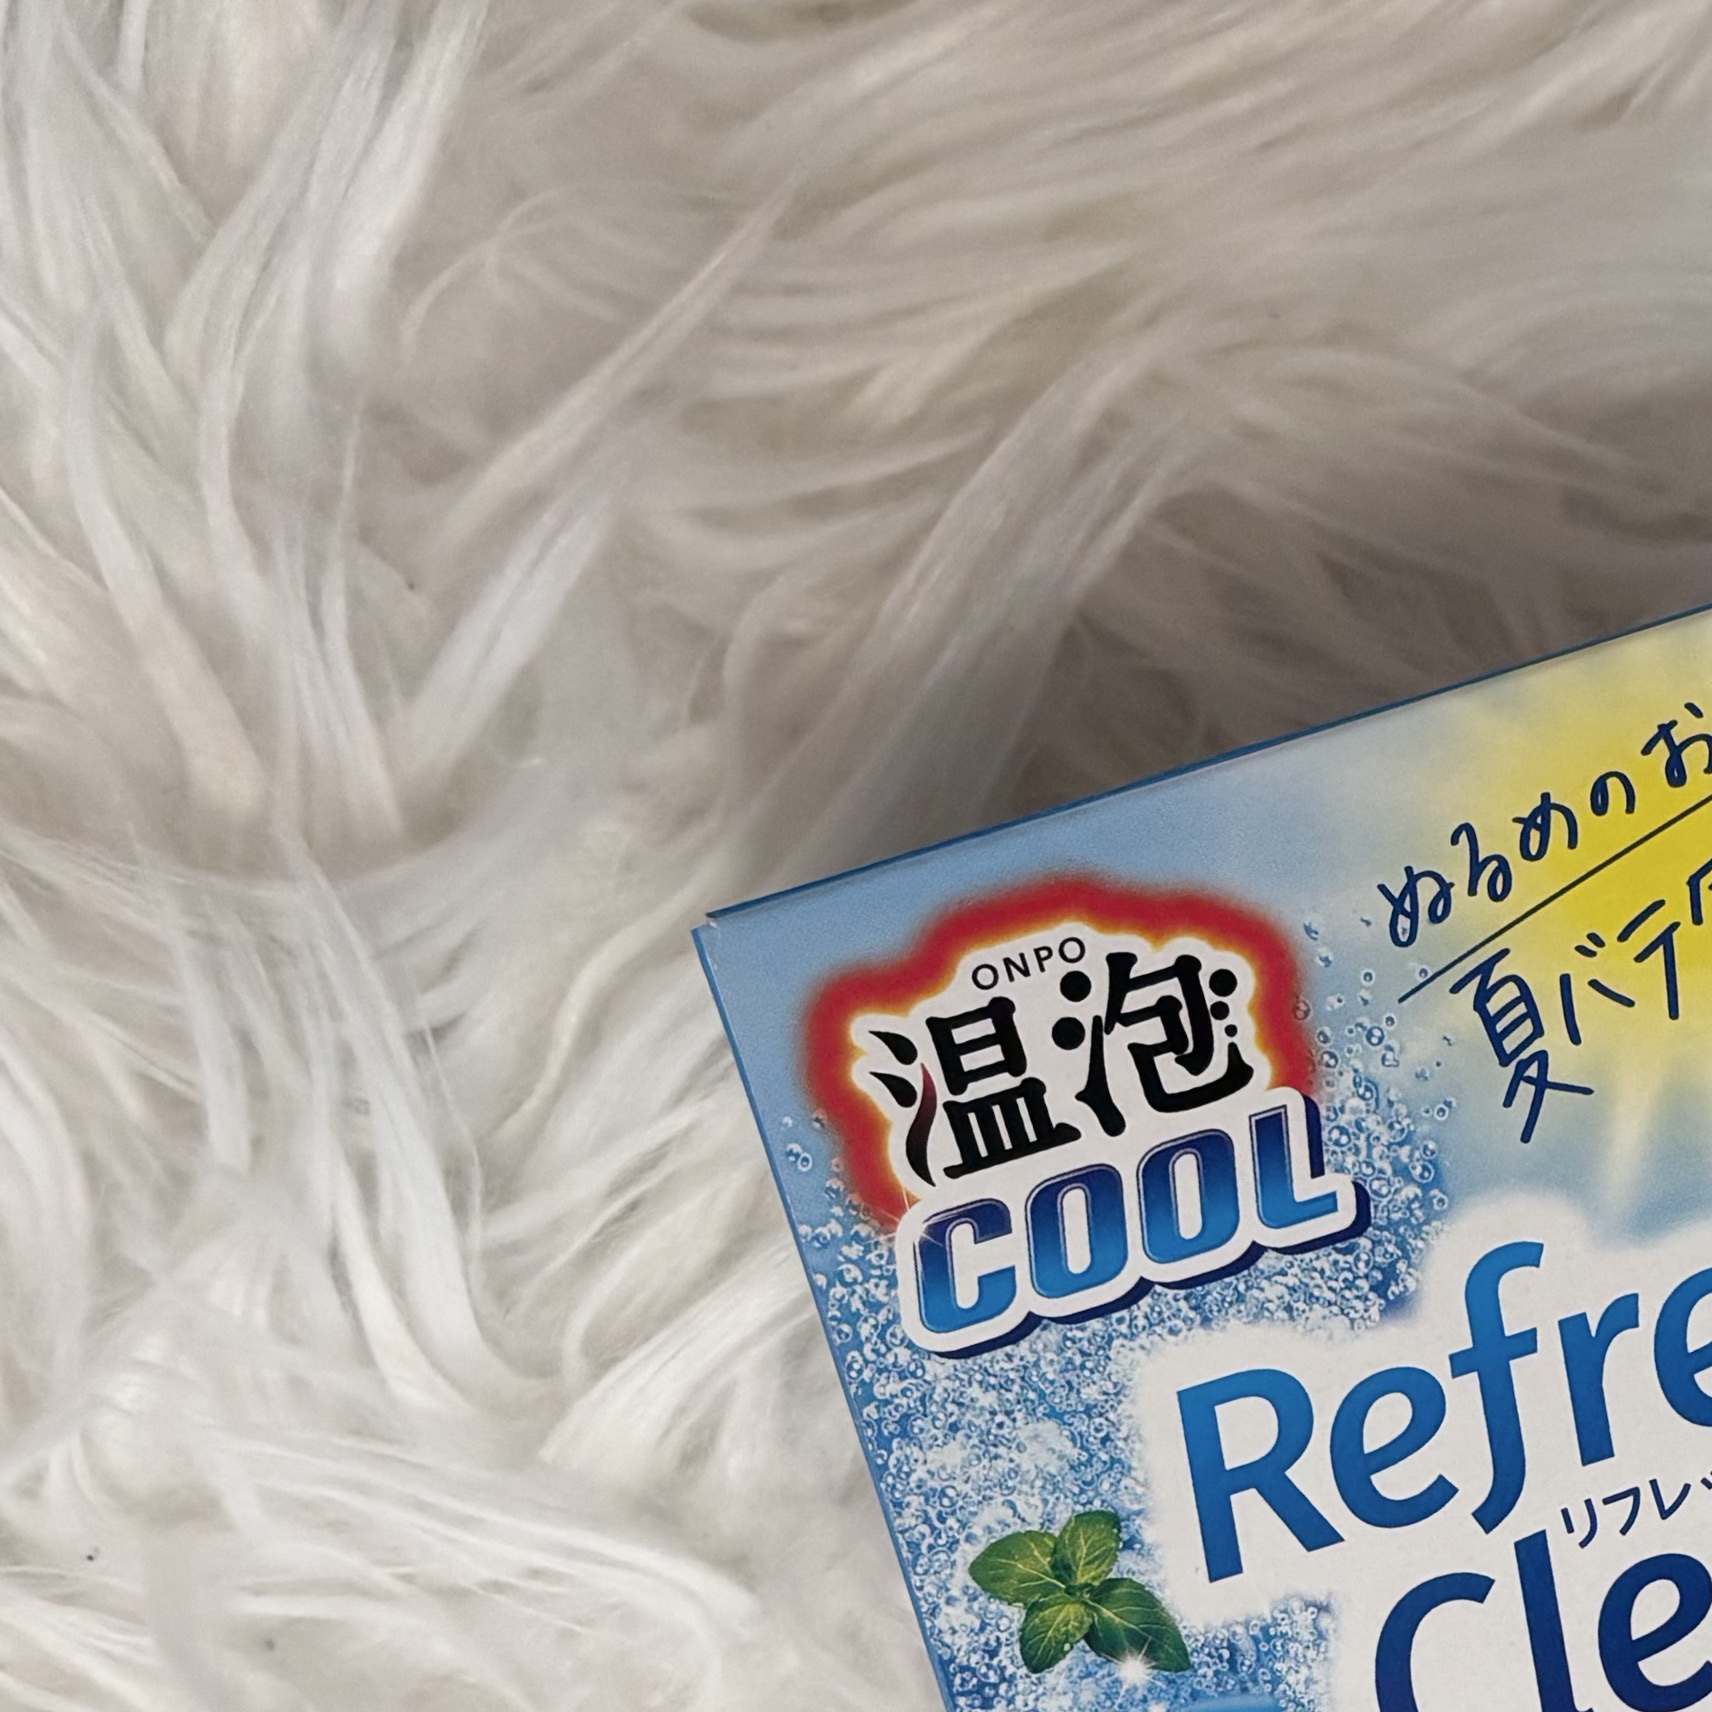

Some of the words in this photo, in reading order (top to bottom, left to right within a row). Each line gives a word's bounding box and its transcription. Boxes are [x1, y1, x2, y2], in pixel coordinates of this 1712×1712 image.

[869, 952, 1254, 1187] 温泡
[971, 936, 1085, 990] ONPO
[914, 1104, 1338, 1335] COOL
